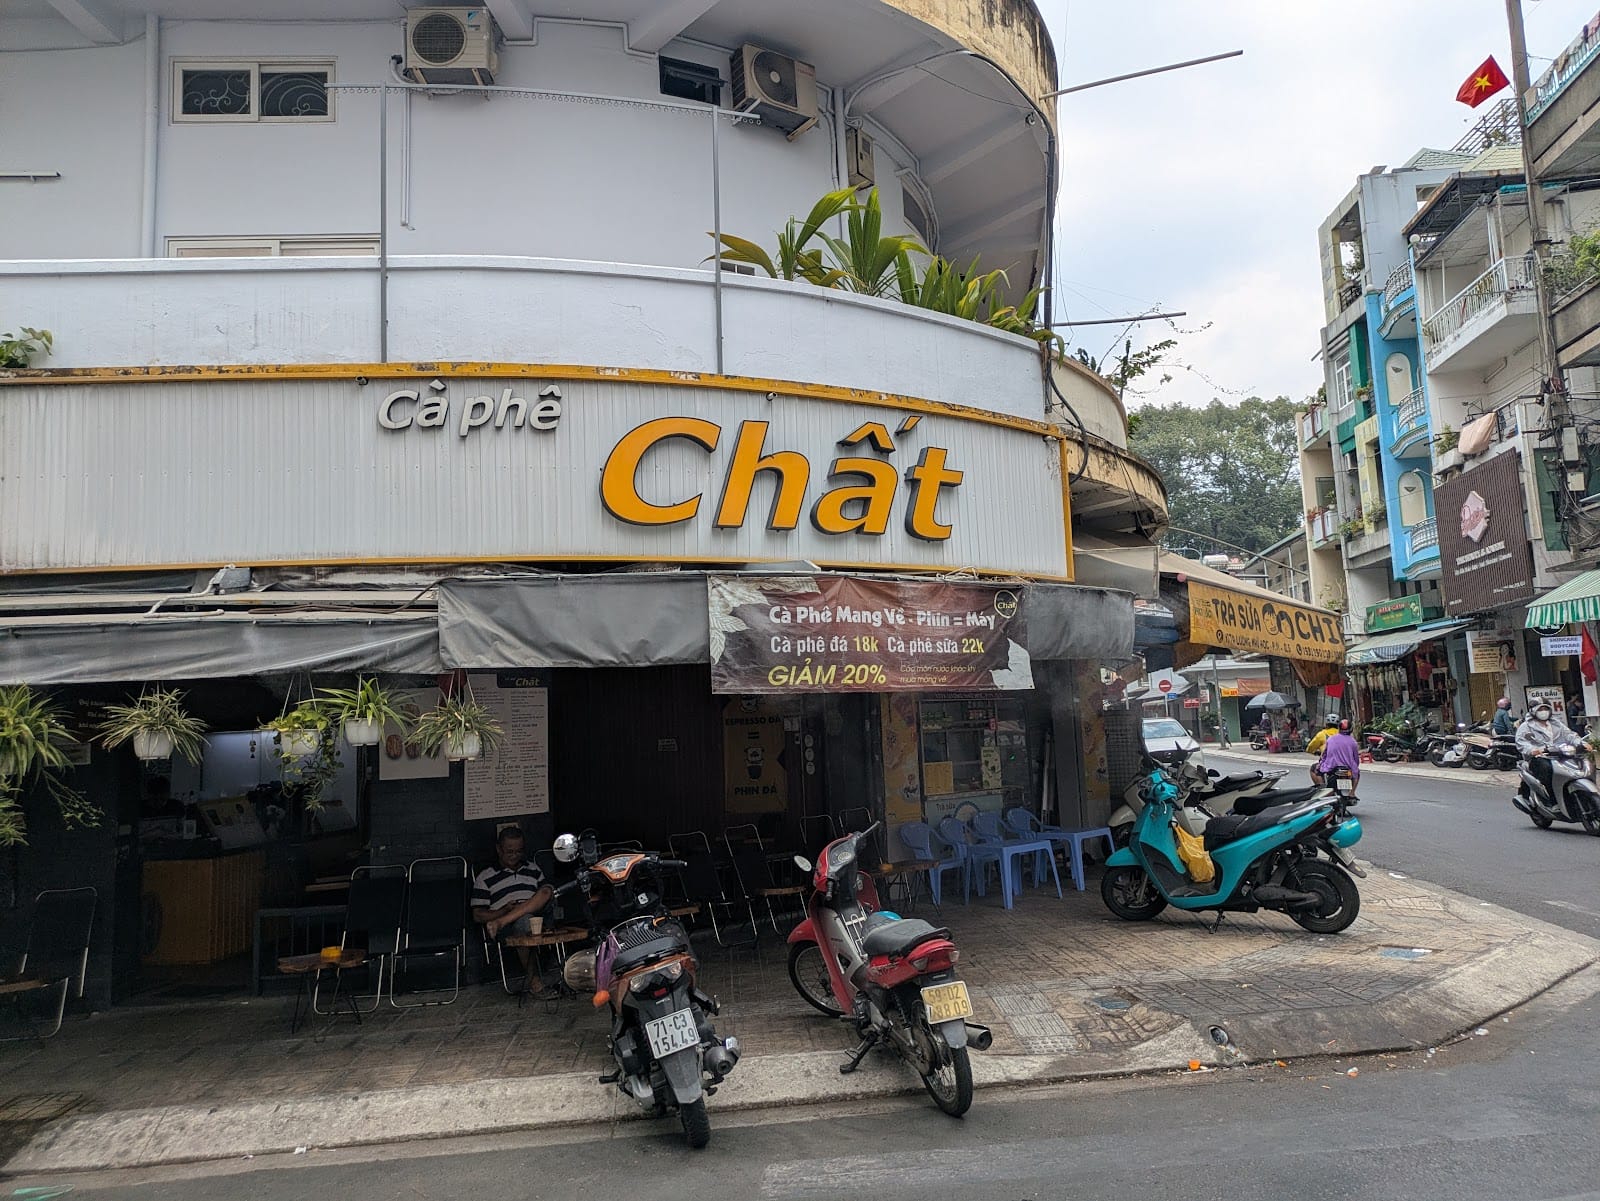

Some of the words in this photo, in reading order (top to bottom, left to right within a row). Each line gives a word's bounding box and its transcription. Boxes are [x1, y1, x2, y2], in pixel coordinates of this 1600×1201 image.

[378, 379, 449, 430] Cà
[459, 384, 562, 437] phê
[599, 416, 964, 541] Chất
[769, 606, 791, 624] Cà
[796, 606, 832, 625] Phê
[836, 607, 882, 627] Mang
[884, 607, 905, 625] Về
[966, 610, 995, 630] Máy
[1211, 594, 1236, 627] TRÀ
[771, 636, 791, 653] Cà
[797, 636, 825, 656] phê
[830, 636, 848, 653] đá
[853, 636, 879, 653] 18k
[887, 637, 904, 653] Cà
[909, 637, 932, 656] phê
[936, 637, 958, 653] sữa
[962, 638, 984, 653] 22k
[768, 658, 835, 686] GIẢM
[841, 664, 887, 685] 20%
[725, 716, 766, 726] ESPRESSO
[734, 785, 759, 795] PHIN
[653, 1013, 688, 1038] 71-C3
[654, 1028, 696, 1055] 154.49
